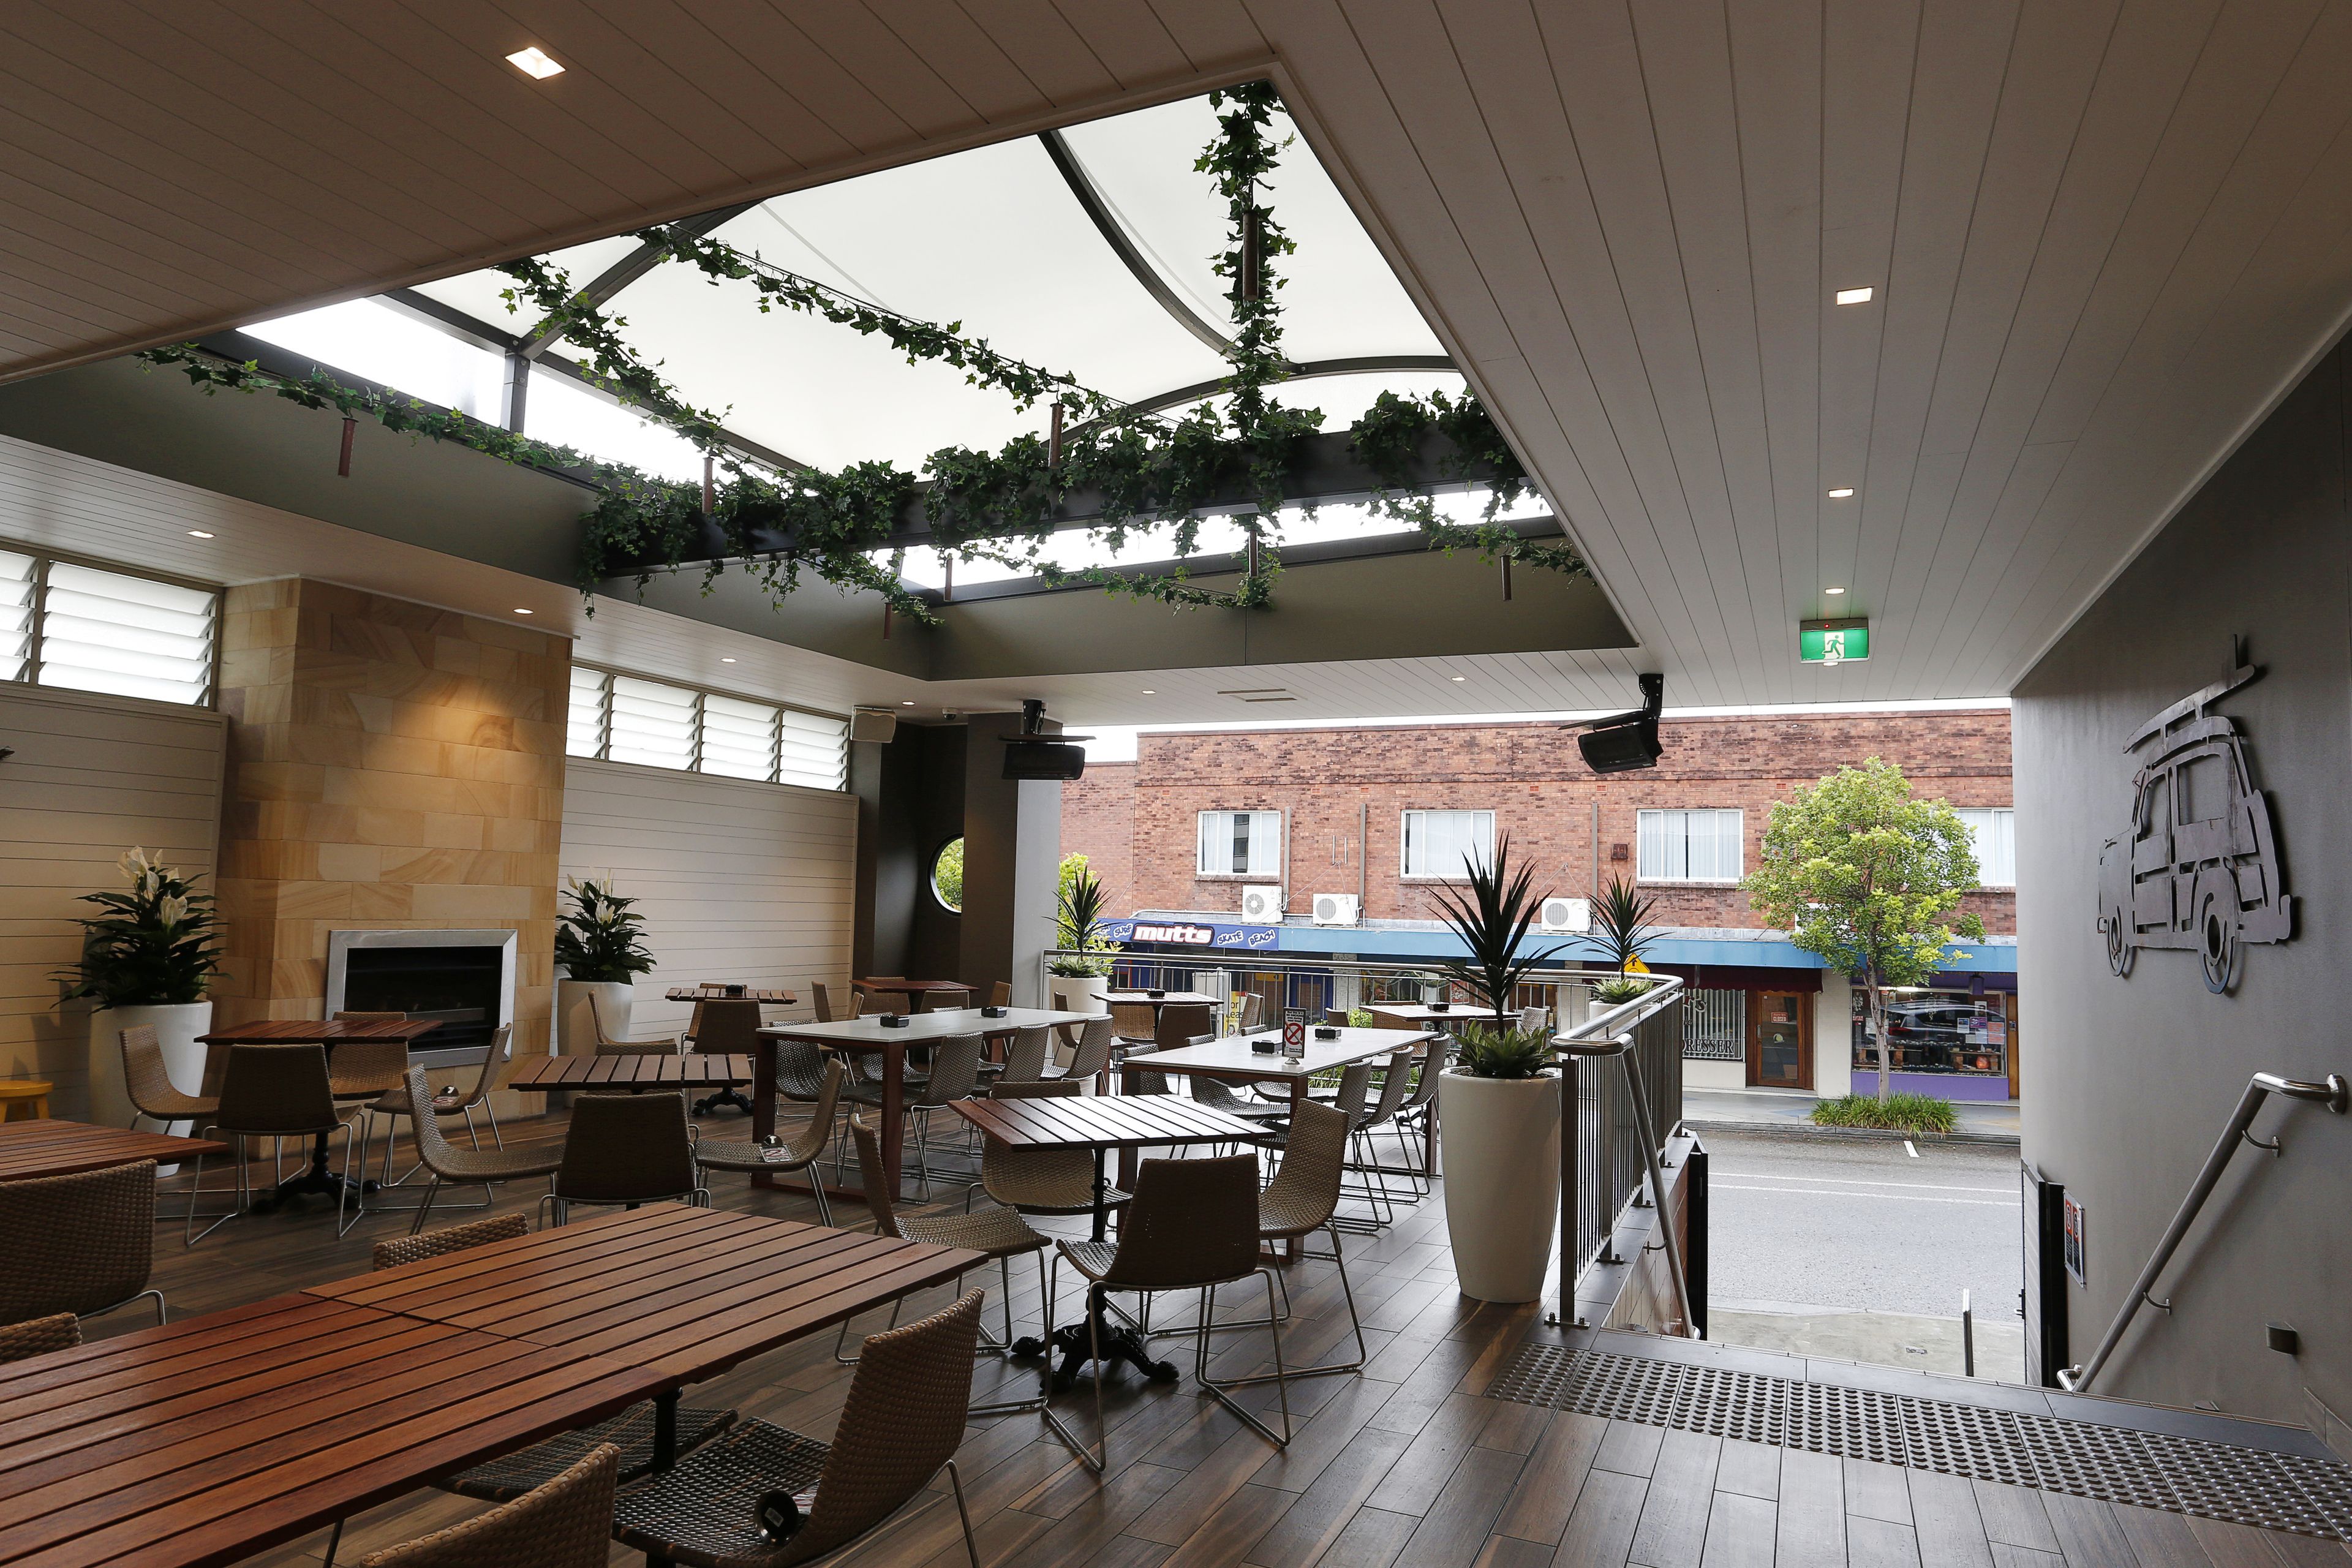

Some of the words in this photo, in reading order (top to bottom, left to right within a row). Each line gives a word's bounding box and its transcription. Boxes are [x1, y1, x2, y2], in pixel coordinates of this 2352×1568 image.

[1114, 923, 1133, 937] SURF
[1133, 924, 1213, 944] mutts
[1218, 930, 1243, 945] SKATE
[1248, 929, 1275, 946] BEACH
